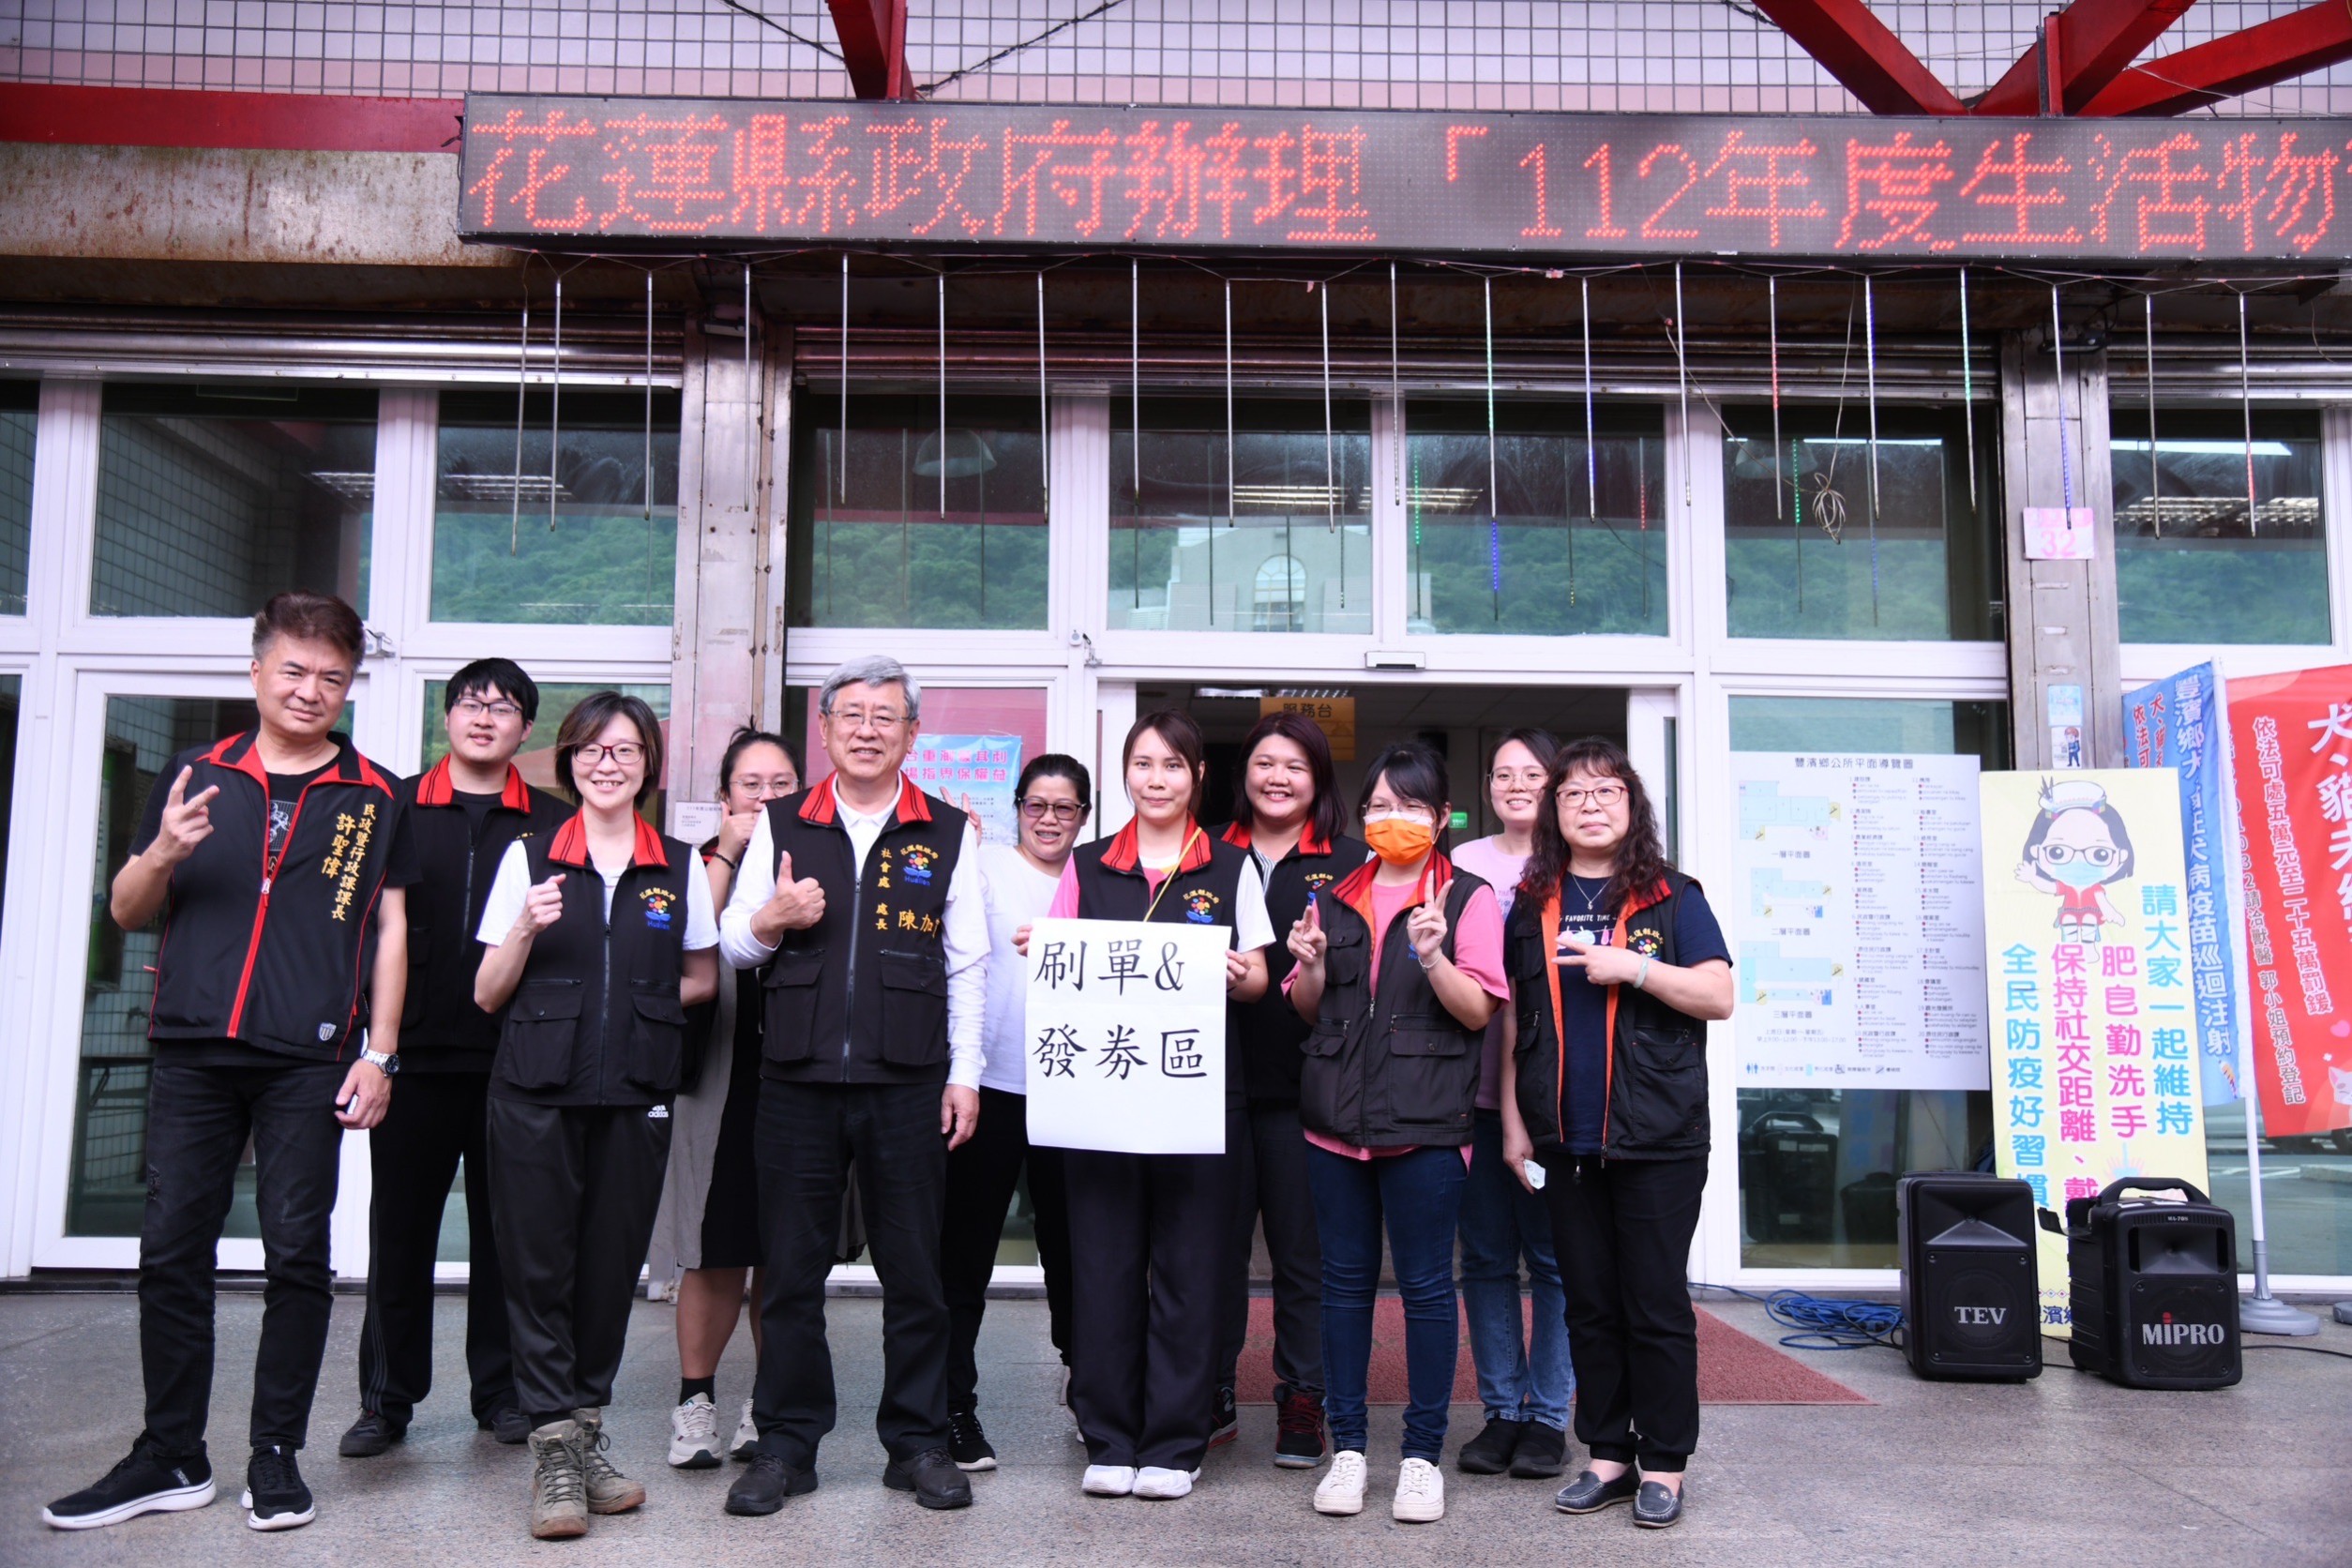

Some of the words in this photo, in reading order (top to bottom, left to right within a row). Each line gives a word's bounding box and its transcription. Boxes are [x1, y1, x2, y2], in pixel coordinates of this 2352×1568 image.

[467, 108, 2352, 253] 花蓮縣政府辦理「112年度生活物
[2041, 530, 2076, 558] 32
[1283, 702, 1333, 718] 服務台
[321, 813, 356, 880] 許聖偉
[331, 803, 377, 922] 民政暨行政課課長
[875, 902, 890, 931] 處長
[898, 909, 941, 939] 陳加
[1564, 913, 1594, 923] FAVORITE
[1596, 913, 1611, 922] TIME
[1033, 938, 1184, 996] 刷單&
[2101, 944, 2148, 1138] 肥皂勤洗手
[2140, 883, 2194, 1137] 請大家一起維持
[2259, 970, 2306, 1105] 郭小姐預約登記
[2001, 942, 2050, 1207] 全民防疫好習慣
[1953, 1305, 2008, 1326] TEV
